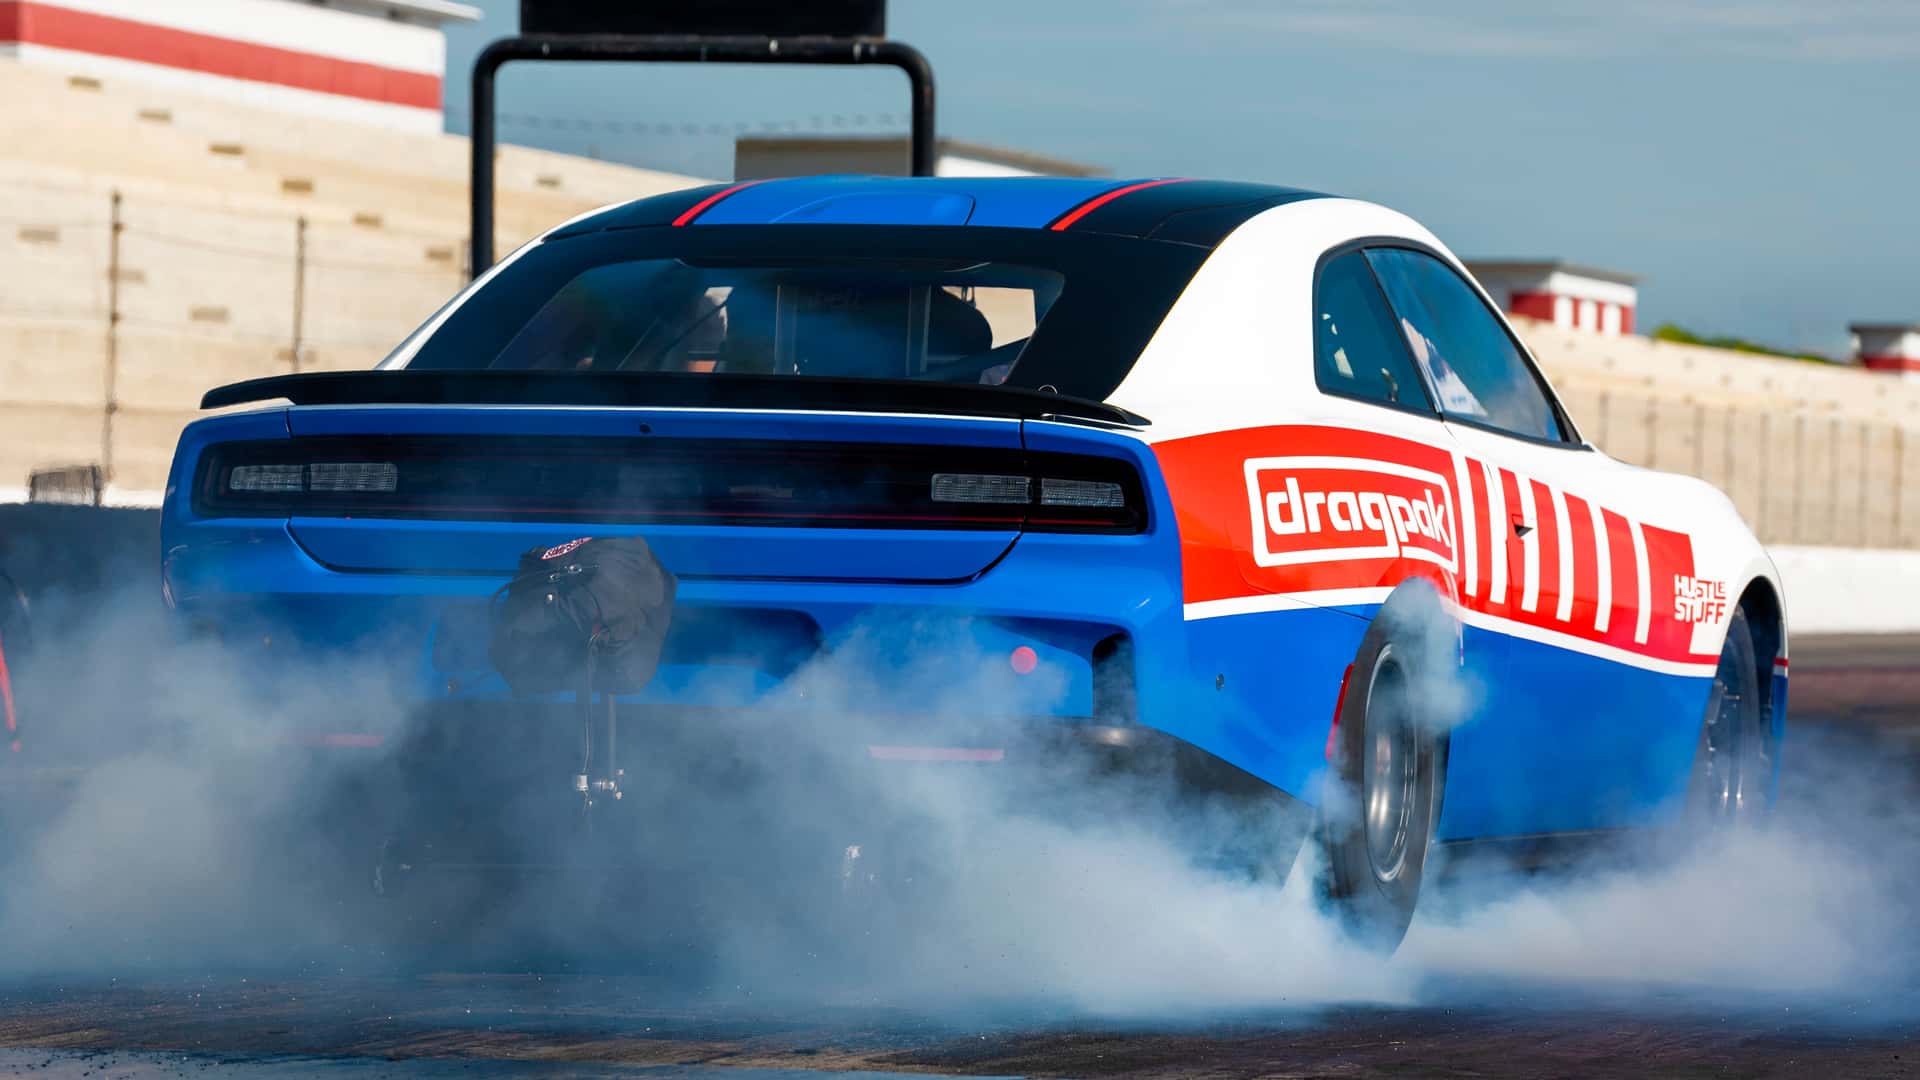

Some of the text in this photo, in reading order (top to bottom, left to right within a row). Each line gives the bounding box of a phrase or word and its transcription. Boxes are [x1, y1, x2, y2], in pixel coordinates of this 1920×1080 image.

[1266, 477, 1451, 549] dragpak
[1674, 573, 1726, 600] HUSTLE
[1674, 595, 1726, 625] STUFF
